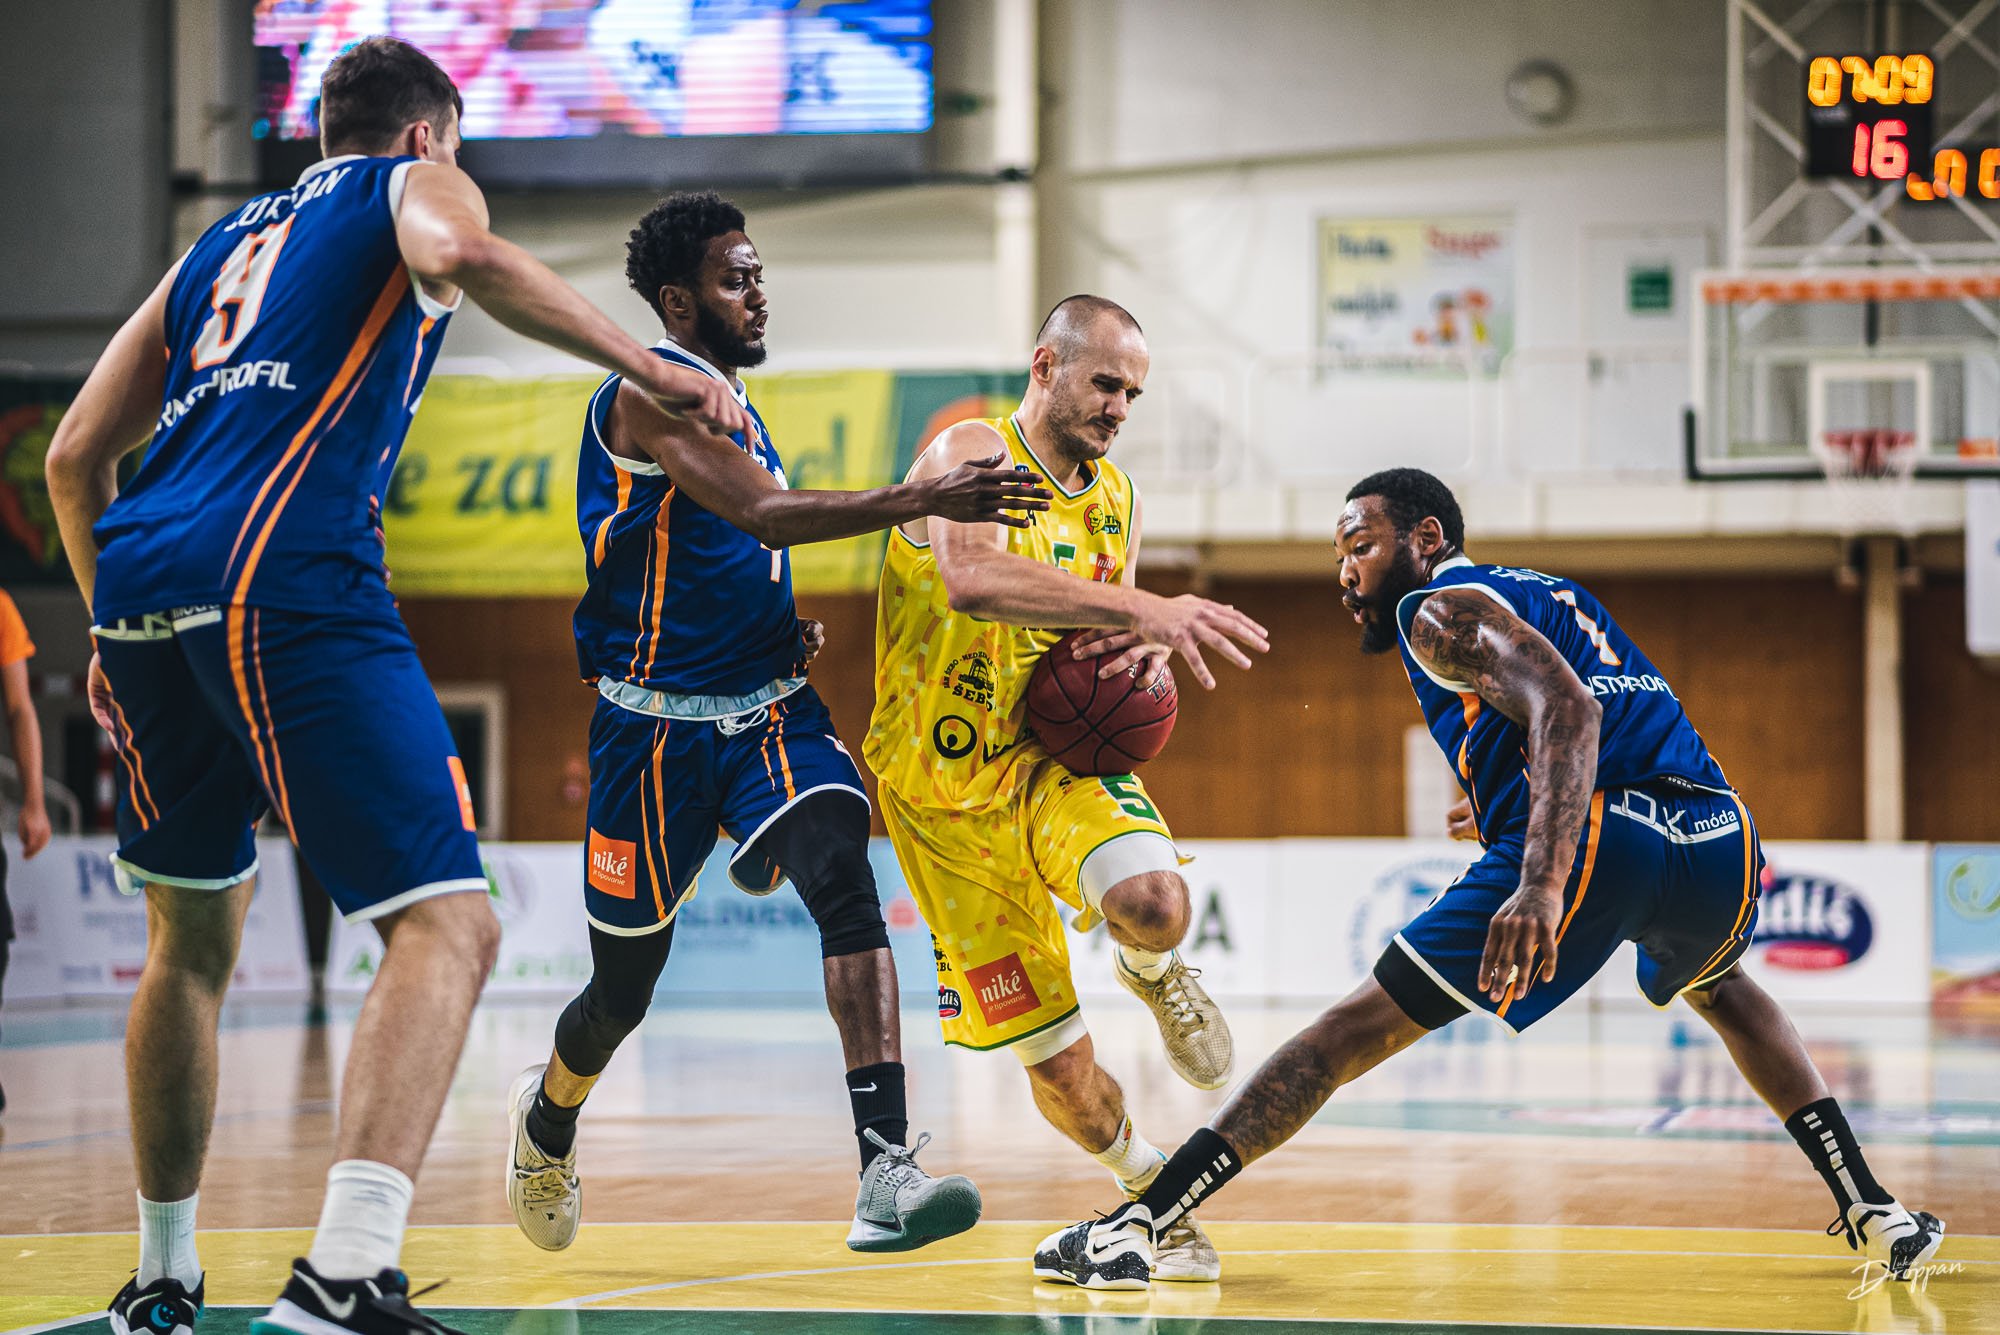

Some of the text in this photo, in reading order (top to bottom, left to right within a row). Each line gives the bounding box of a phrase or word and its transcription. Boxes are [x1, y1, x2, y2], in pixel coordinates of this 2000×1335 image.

[1852, 119, 1909, 179] 16
[1097, 773, 1162, 826] 5
[1693, 809, 1738, 832] móda
[593, 851, 628, 877] niké
[597, 871, 626, 886] tipovanie
[980, 970, 1023, 1004] niké
[994, 992, 1027, 1010] tipovanie
